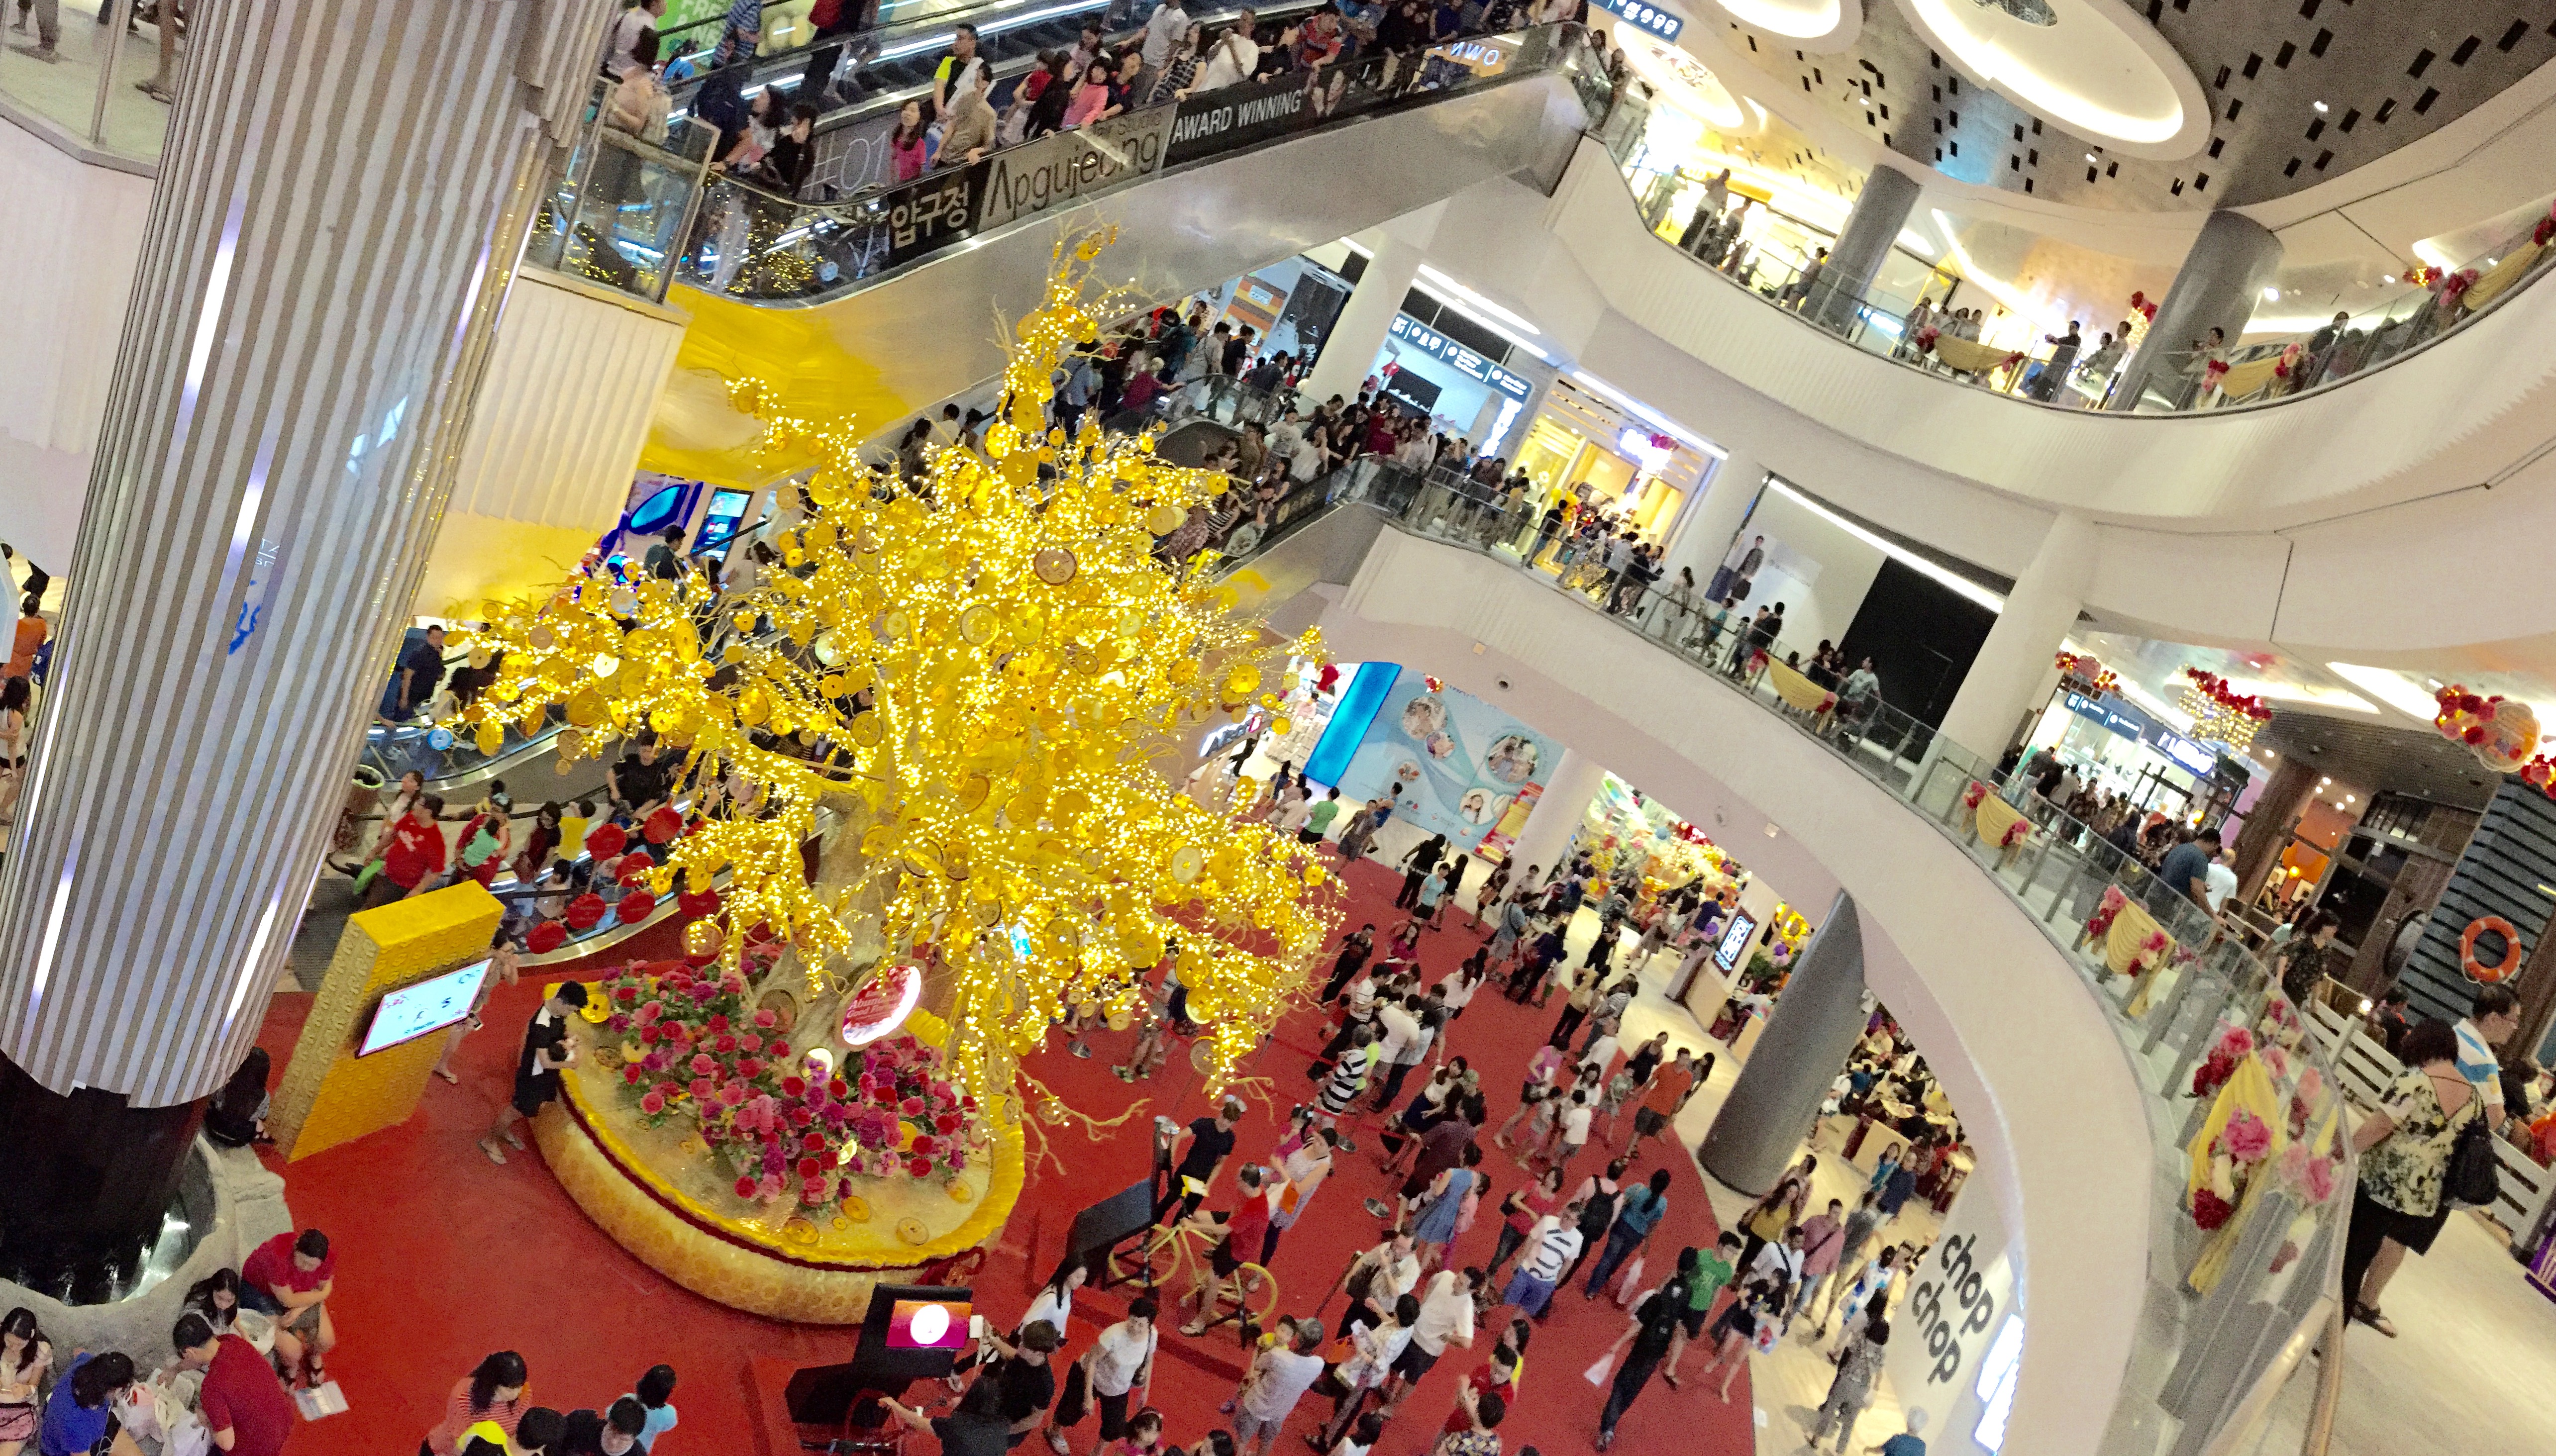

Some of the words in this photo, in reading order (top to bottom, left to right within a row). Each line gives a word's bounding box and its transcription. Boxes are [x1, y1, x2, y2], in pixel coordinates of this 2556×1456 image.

[1171, 105, 1233, 144] AWARD
[1238, 89, 1303, 127] WINNING
[891, 181, 969, 249] 압구정
[1941, 1233, 1994, 1338] chop
[1911, 1281, 1961, 1386] chop
